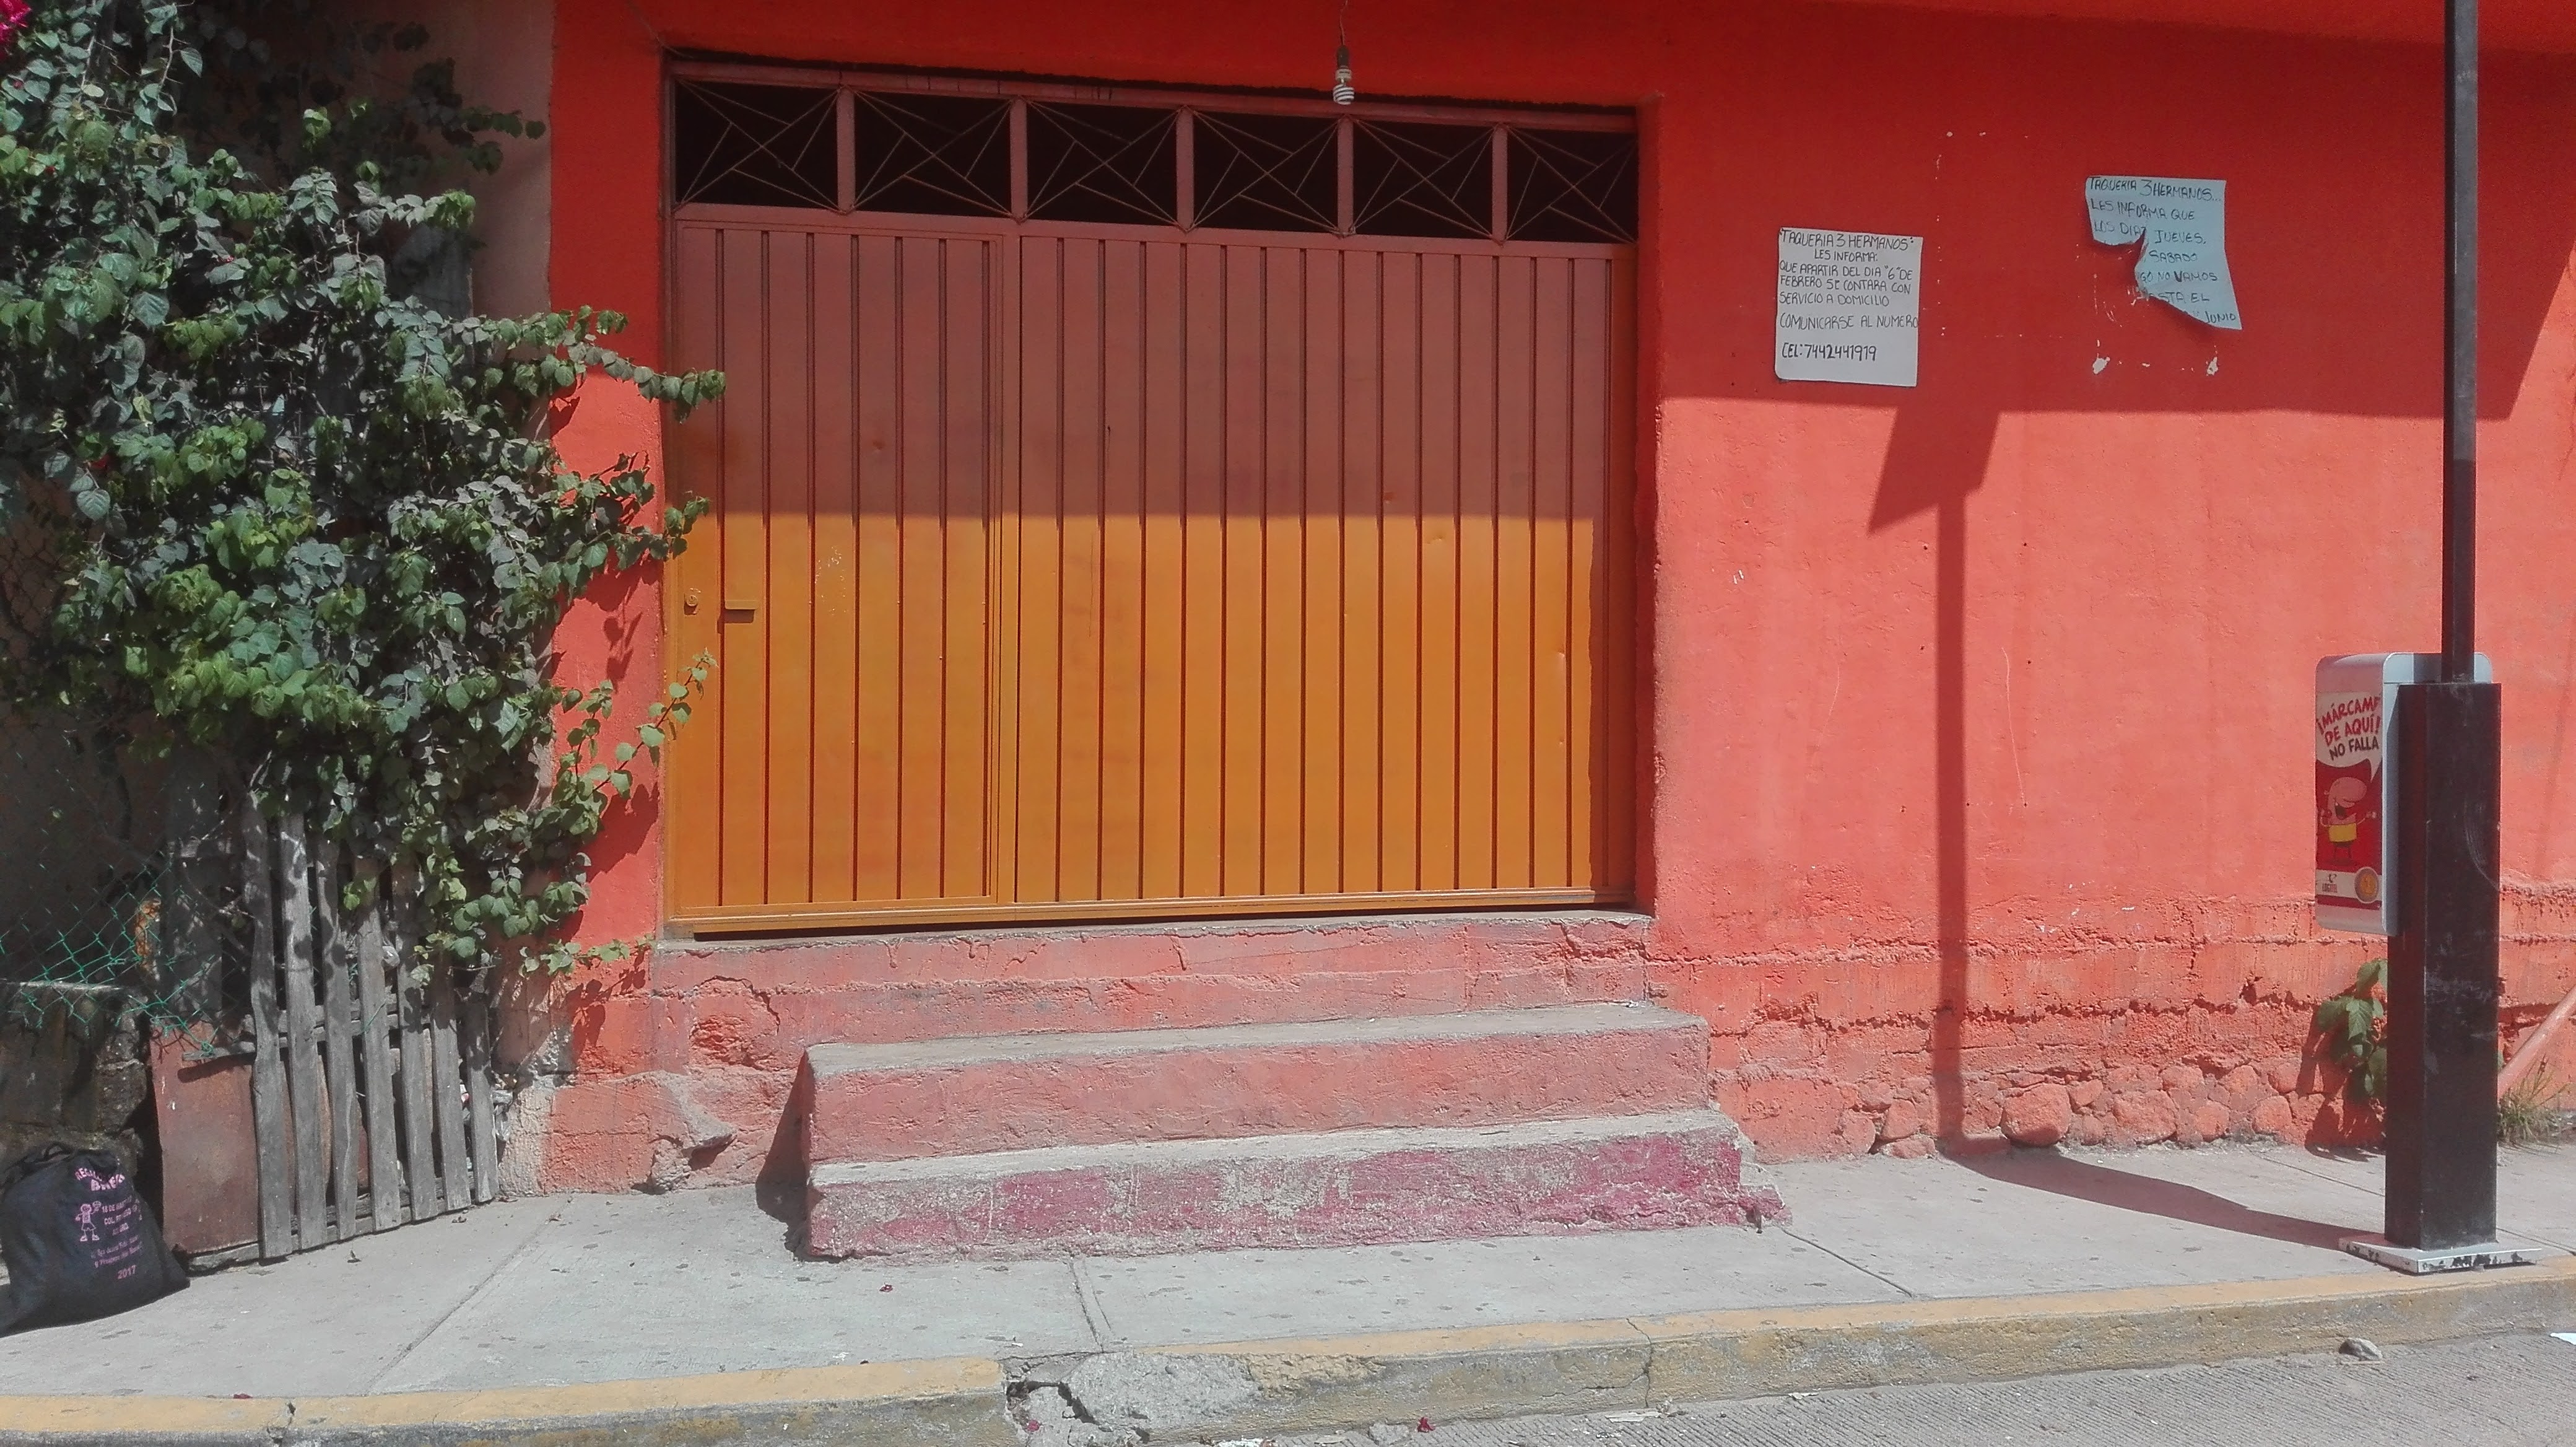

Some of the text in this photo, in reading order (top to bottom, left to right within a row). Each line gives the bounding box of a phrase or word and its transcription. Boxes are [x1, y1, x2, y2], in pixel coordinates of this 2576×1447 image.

[2089, 177, 2137, 191] TAQUERIA
[2091, 198, 2195, 220] LES INFORMA QUE
[2094, 219, 2115, 233] LOS
[1837, 234, 1846, 247] 3
[1815, 248, 1878, 263] LES INFORMA:
[2148, 250, 2198, 263] SABADO
[1779, 260, 1798, 273] QUE
[1799, 263, 1838, 276] APARTIR
[1843, 266, 1861, 277] DEL
[1864, 266, 1881, 278] DIA
[2157, 271, 2170, 282] NO
[2174, 270, 2218, 282] VAMOS
[1780, 274, 1911, 295] FEBRERO SE CONTARA CON
[1779, 292, 1889, 307] SERVICIO A DOMICILIO
[2190, 292, 2210, 303] EL
[1780, 313, 1918, 330] COMUNICARSE AL NUMERO
[2204, 311, 2236, 323] JUNIO
[2325, 714, 2381, 746] DE AQUÍ!
[2329, 735, 2379, 761] NO FALLA
[117, 1264, 137, 1280] 2017
